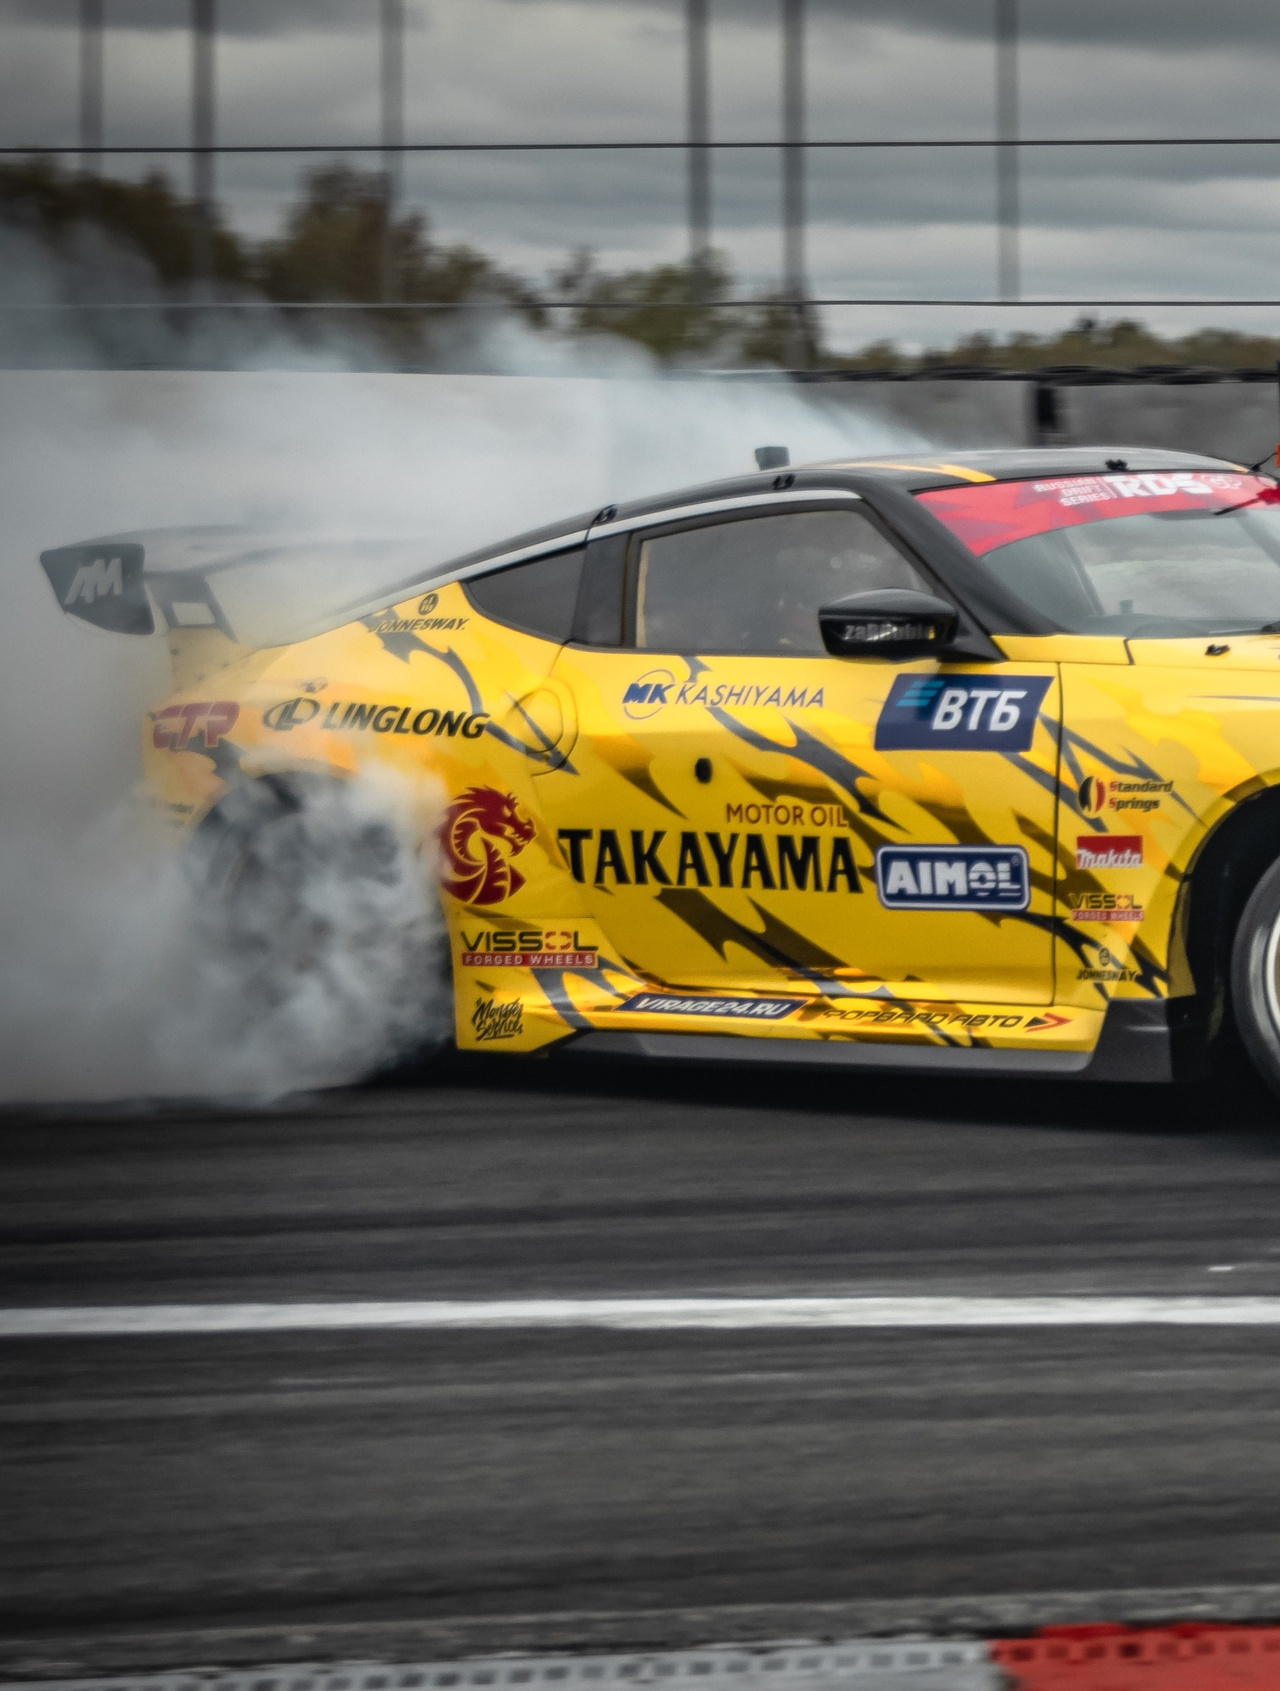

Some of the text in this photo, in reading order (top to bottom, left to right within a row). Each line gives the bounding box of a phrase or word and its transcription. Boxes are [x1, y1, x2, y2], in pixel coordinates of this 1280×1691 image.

[1061, 483, 1103, 498] DRIFT
[1103, 472, 1214, 498] RDS
[1059, 491, 1112, 506] SERIES
[369, 617, 470, 634] JONNESWAY
[622, 681, 825, 709] MK KASHIYAMA
[320, 701, 491, 739] LINGLONG
[931, 689, 1029, 732] ВТБ
[1109, 780, 1174, 793] Standard
[1108, 797, 1160, 813] Springs
[726, 803, 849, 828] MOTOR OIL
[558, 828, 864, 895] TAKAYAMA
[886, 861, 1022, 897] AIMOL
[1068, 893, 1143, 909] VISSOL
[460, 930, 599, 951] VISSOL
[465, 954, 594, 965] FORGED WHEELS
[635, 997, 791, 1016] VIRAGE24.RU
